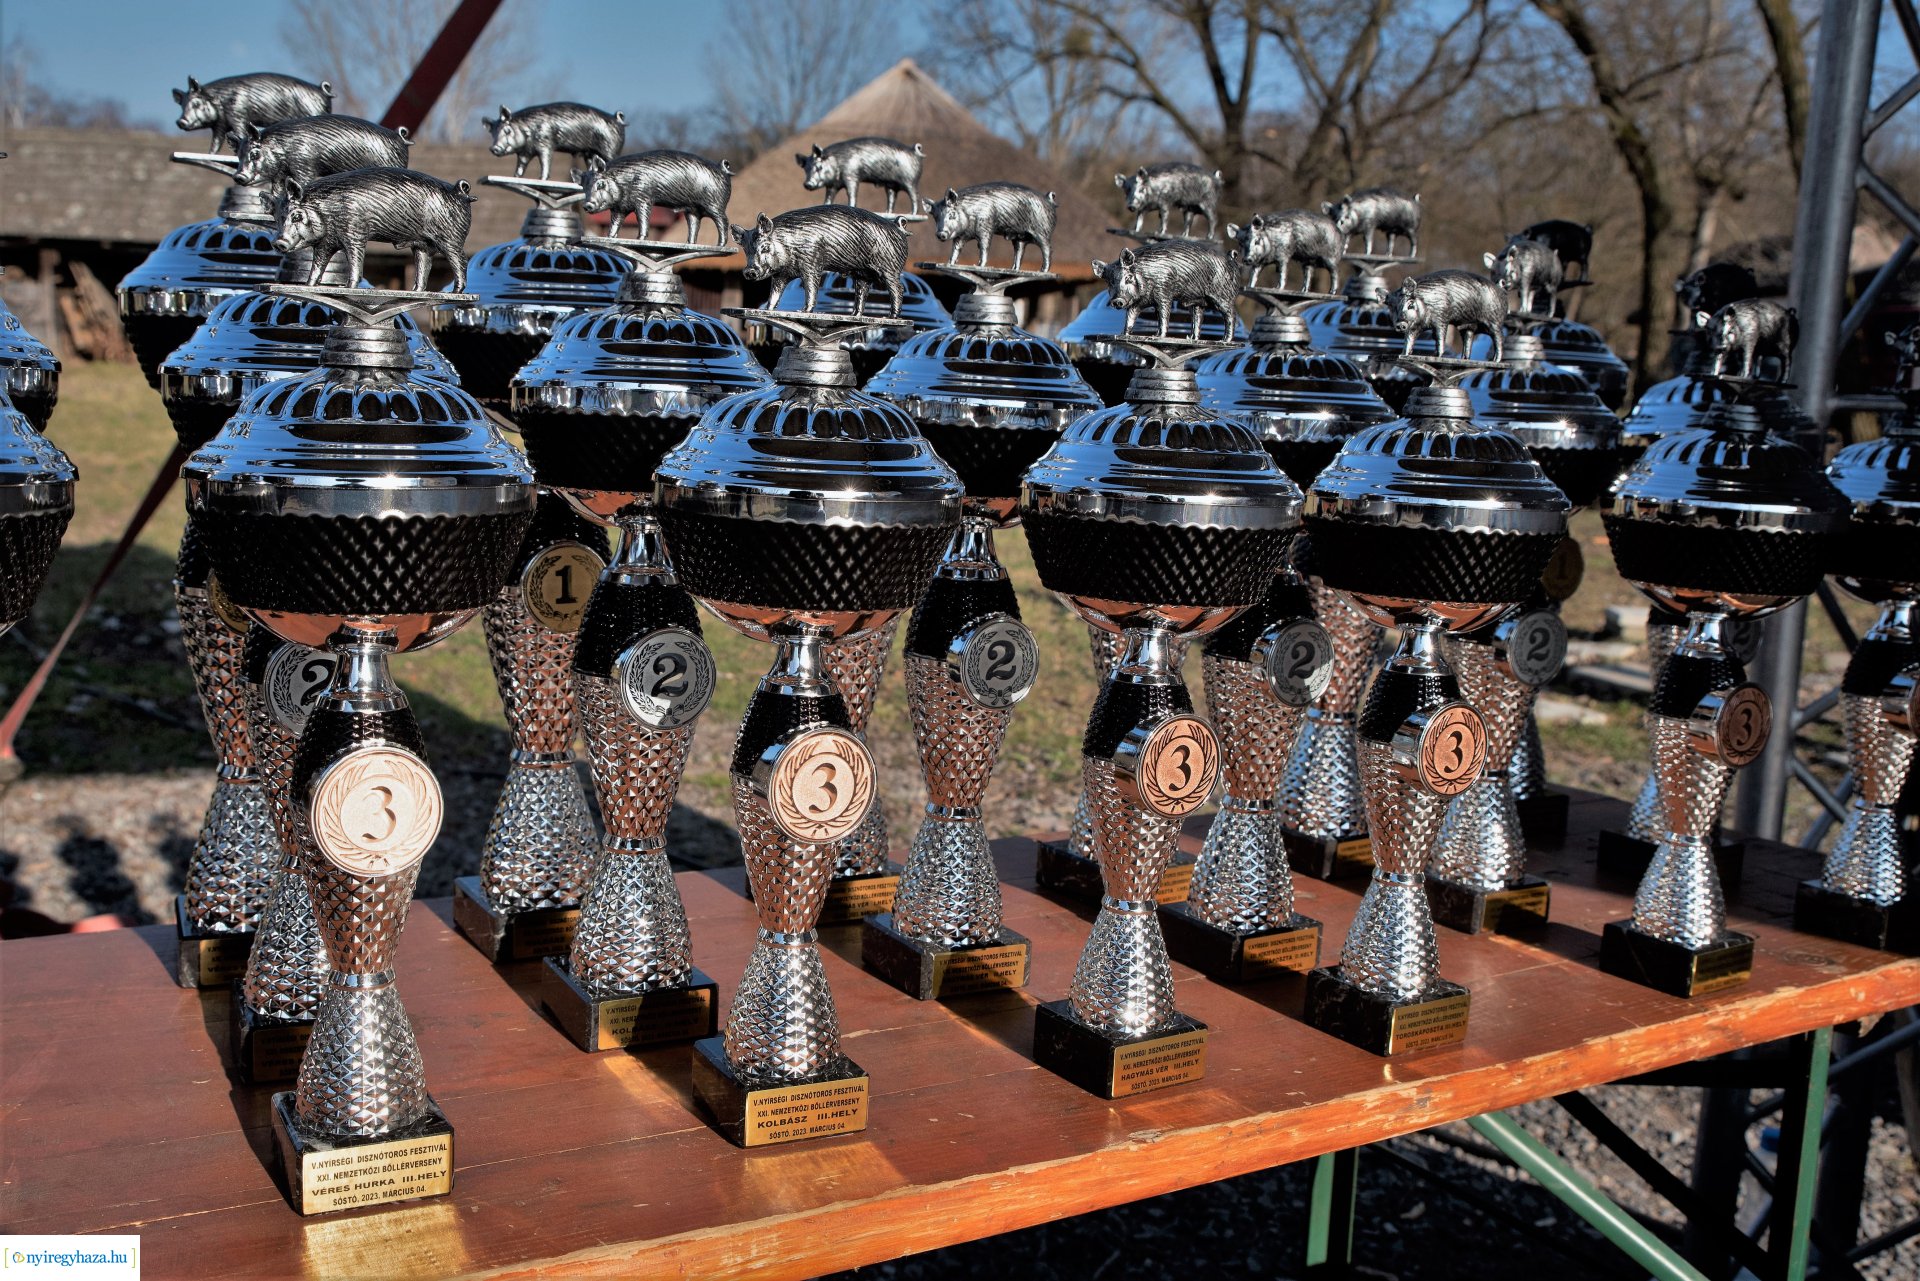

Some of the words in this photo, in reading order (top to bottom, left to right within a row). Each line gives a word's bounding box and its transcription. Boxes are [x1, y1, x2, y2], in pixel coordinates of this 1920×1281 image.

[555, 564, 578, 604] 1
[986, 640, 1016, 681] 2
[1288, 640, 1316, 680] 2
[1526, 627, 1550, 662] 2
[300, 658, 336, 706] 2
[650, 652, 689, 698] 2
[1736, 708, 1752, 746] 3
[1168, 744, 1192, 792] 3
[1444, 730, 1463, 774] 3
[808, 762, 838, 814] 3
[361, 785, 397, 844] 3
[1121, 1068, 1154, 1081] HAGYMÁS
[1155, 1065, 1169, 1074] VÉR
[753, 1095, 788, 1106] V.NYÍRSÉGI
[790, 1088, 833, 1102] DISZNÓTOROS
[834, 1085, 865, 1096] FESZTIVÁL
[771, 1104, 809, 1116] NEMZETKÖZI
[810, 1097, 861, 1110] BÖLLÉRVERSENY
[757, 1115, 808, 1129] KOLBÁSZ
[817, 1108, 859, 1120] III.HELY
[809, 1123, 836, 1133] MÁRCIUS
[311, 1157, 353, 1170] V.NYÍRSÉGI
[357, 1148, 408, 1163] DISZNÓTOROS
[410, 1142, 448, 1155] FESZTIVÁL
[317, 1174, 331, 1183] XXI.
[333, 1166, 380, 1180] NEMZETKÖZI
[382, 1157, 443, 1173] BÖLLÉRVERSENY
[312, 1184, 350, 1196] VÉRES
[354, 1178, 396, 1190] HURKA
[402, 1170, 447, 1183] III.HELY
[361, 1193, 380, 1201] 2023.
[382, 1186, 415, 1198] MÁRCIUS
